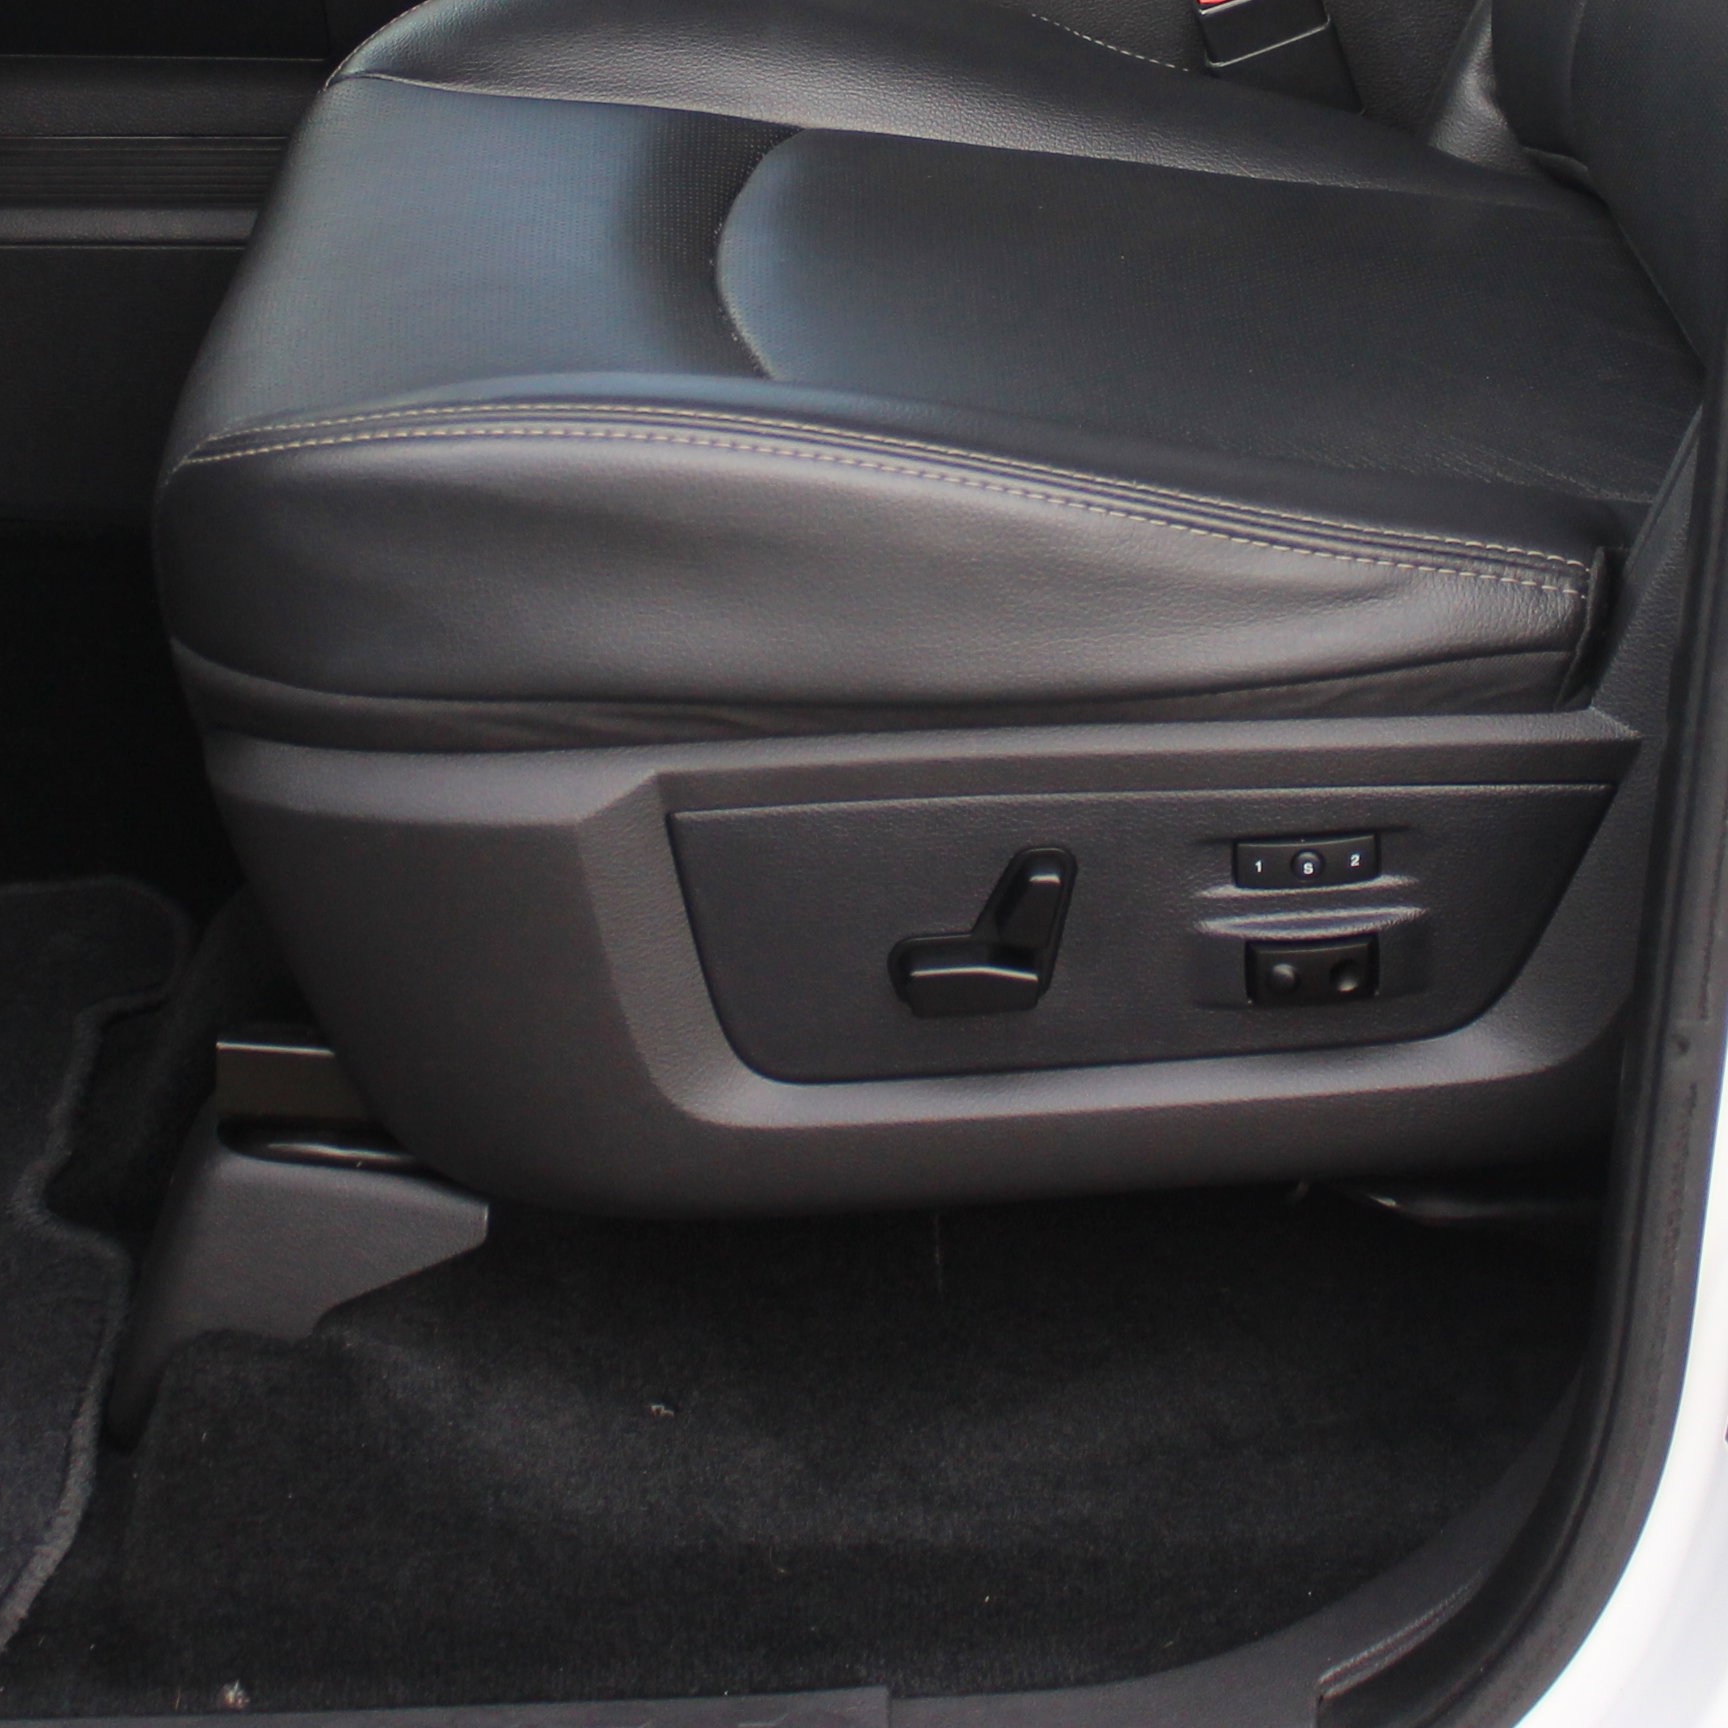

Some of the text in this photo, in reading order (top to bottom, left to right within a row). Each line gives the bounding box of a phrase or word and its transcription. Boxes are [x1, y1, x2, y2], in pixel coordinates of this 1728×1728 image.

[1255, 854, 1360, 874] 1 S 2
